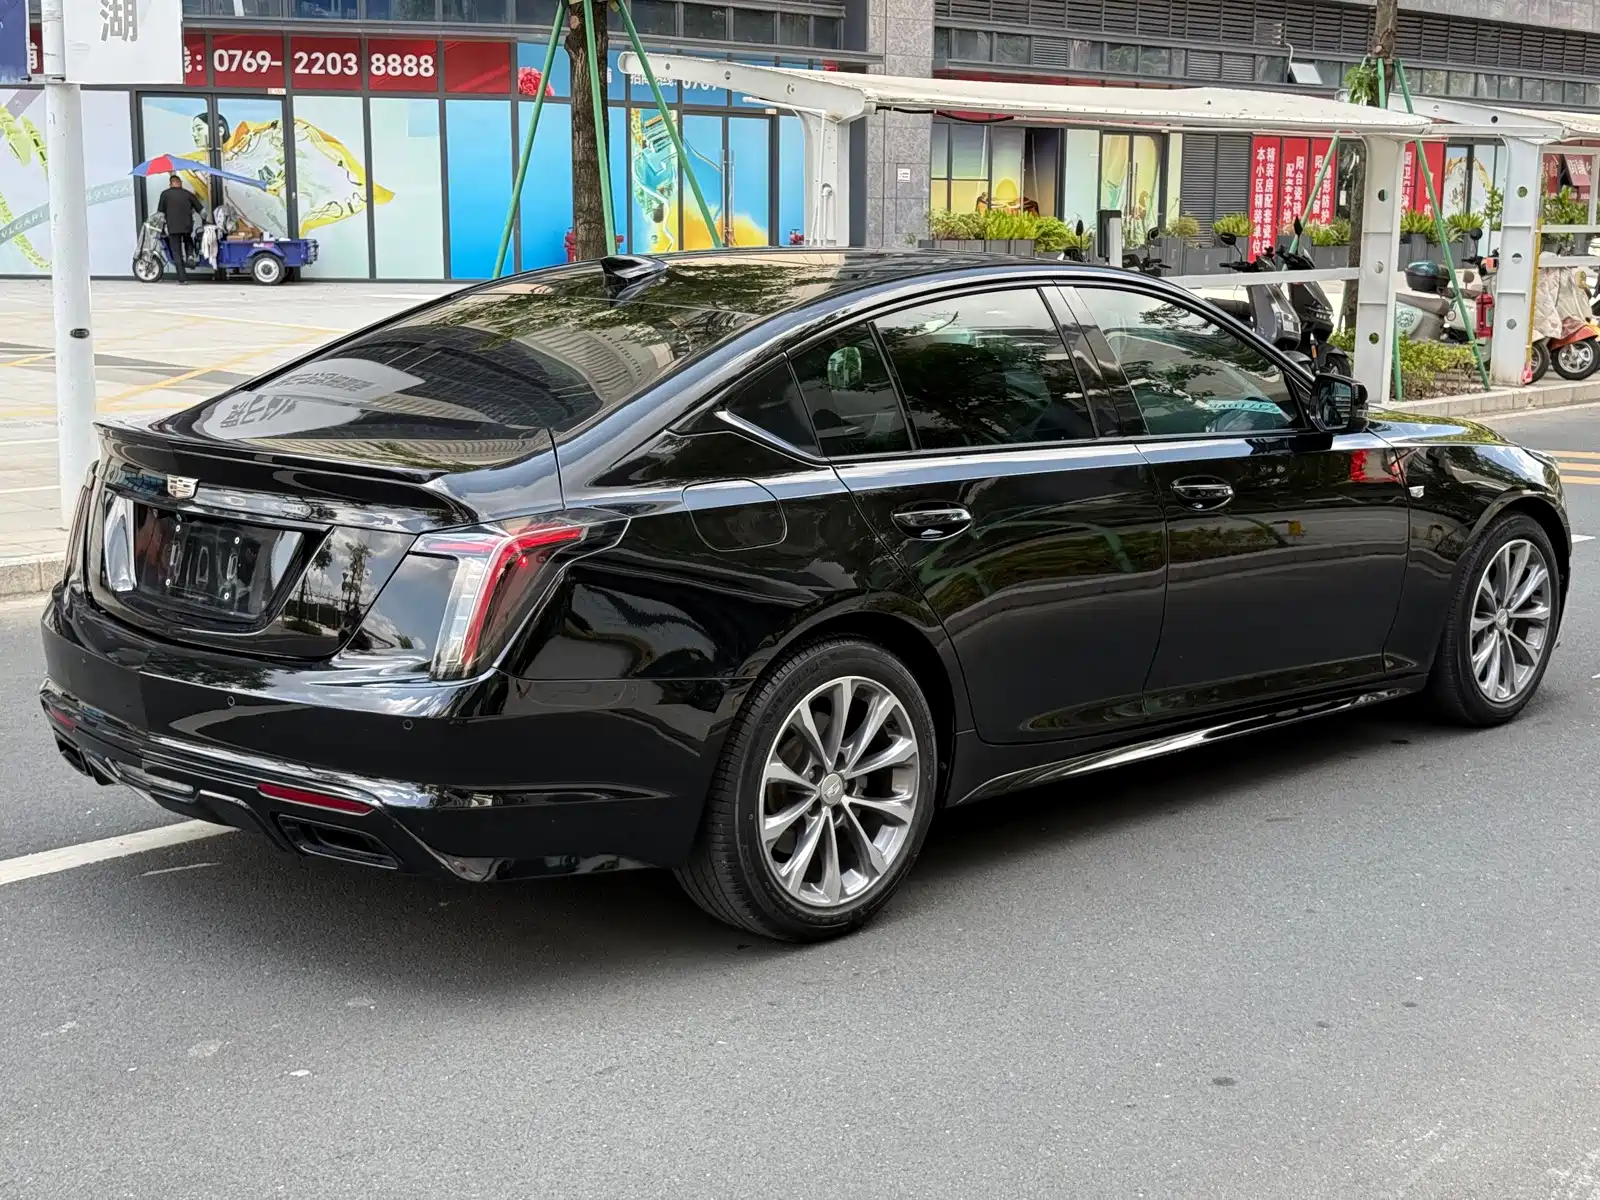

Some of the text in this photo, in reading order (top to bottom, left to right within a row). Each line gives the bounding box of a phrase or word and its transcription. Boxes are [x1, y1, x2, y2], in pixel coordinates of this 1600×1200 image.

[100, 0, 138, 42] 湖
[213, 49, 283, 73] 0769-
[293, 52, 358, 75] 2203
[370, 53, 435, 77] 8888
[1252, 146, 1266, 255] 本小区精装单位
